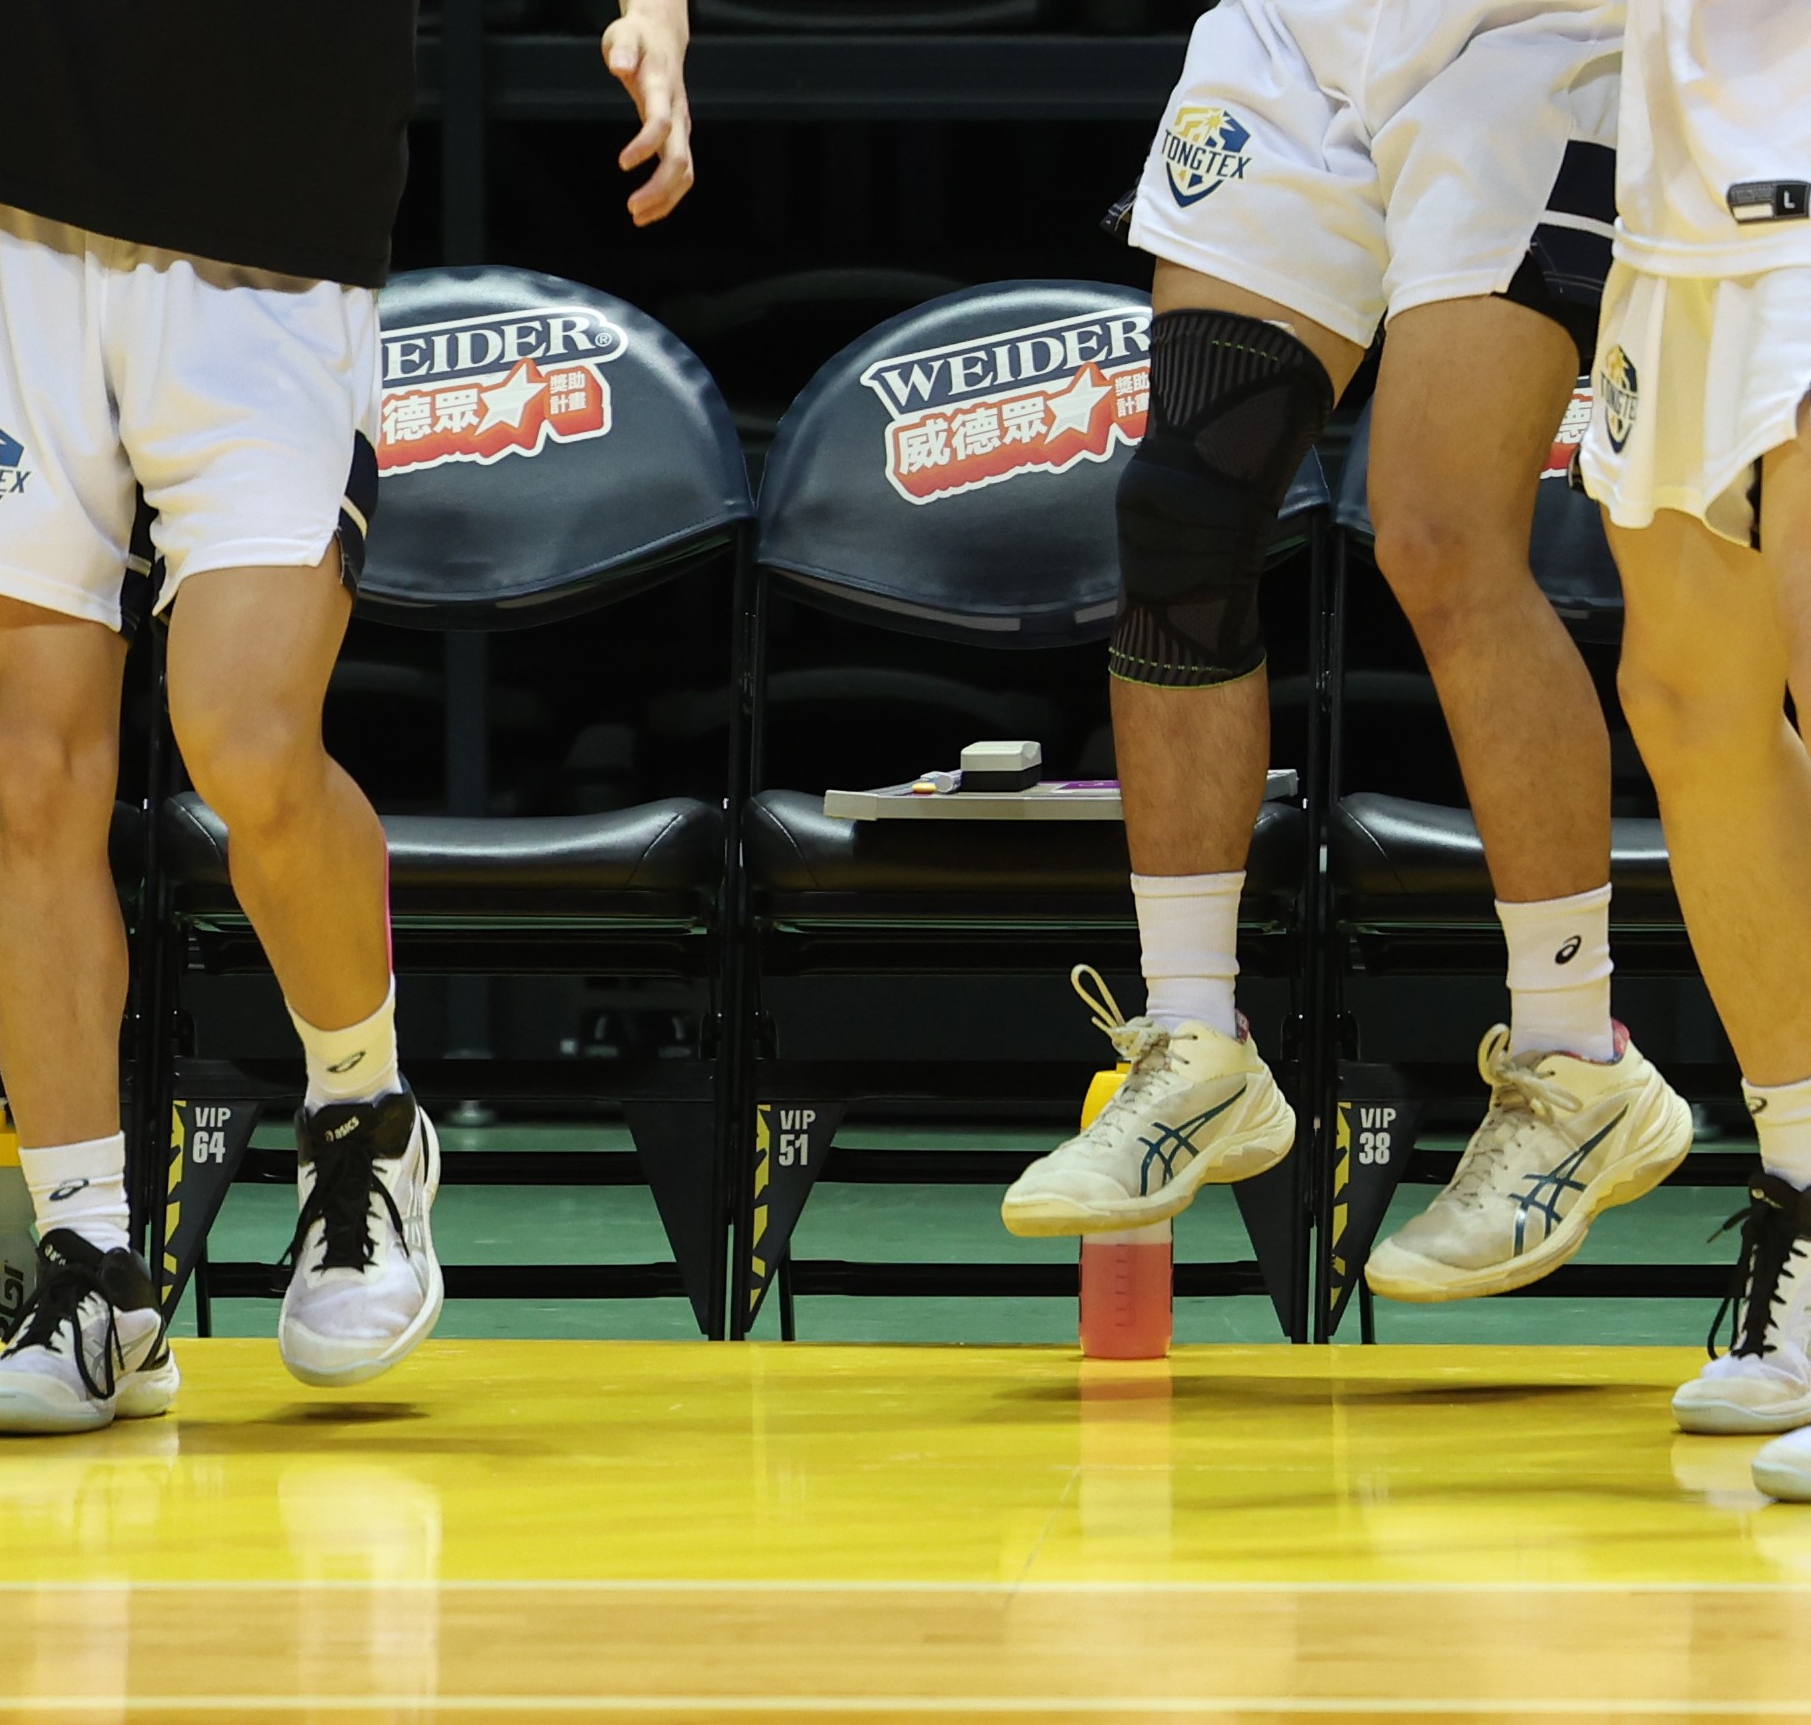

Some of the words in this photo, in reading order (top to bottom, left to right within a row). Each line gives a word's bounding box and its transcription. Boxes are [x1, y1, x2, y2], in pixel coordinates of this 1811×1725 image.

[1160, 129, 1253, 181] TONGTEX
[1783, 189, 1796, 210] L
[898, 396, 1049, 475] 威德眾
[194, 1106, 232, 1128] VIP
[779, 1109, 817, 1131] VIP
[1359, 1107, 1397, 1129] VIP
[191, 1130, 227, 1164] 64
[777, 1133, 810, 1167] 51
[1358, 1131, 1392, 1165] 38
